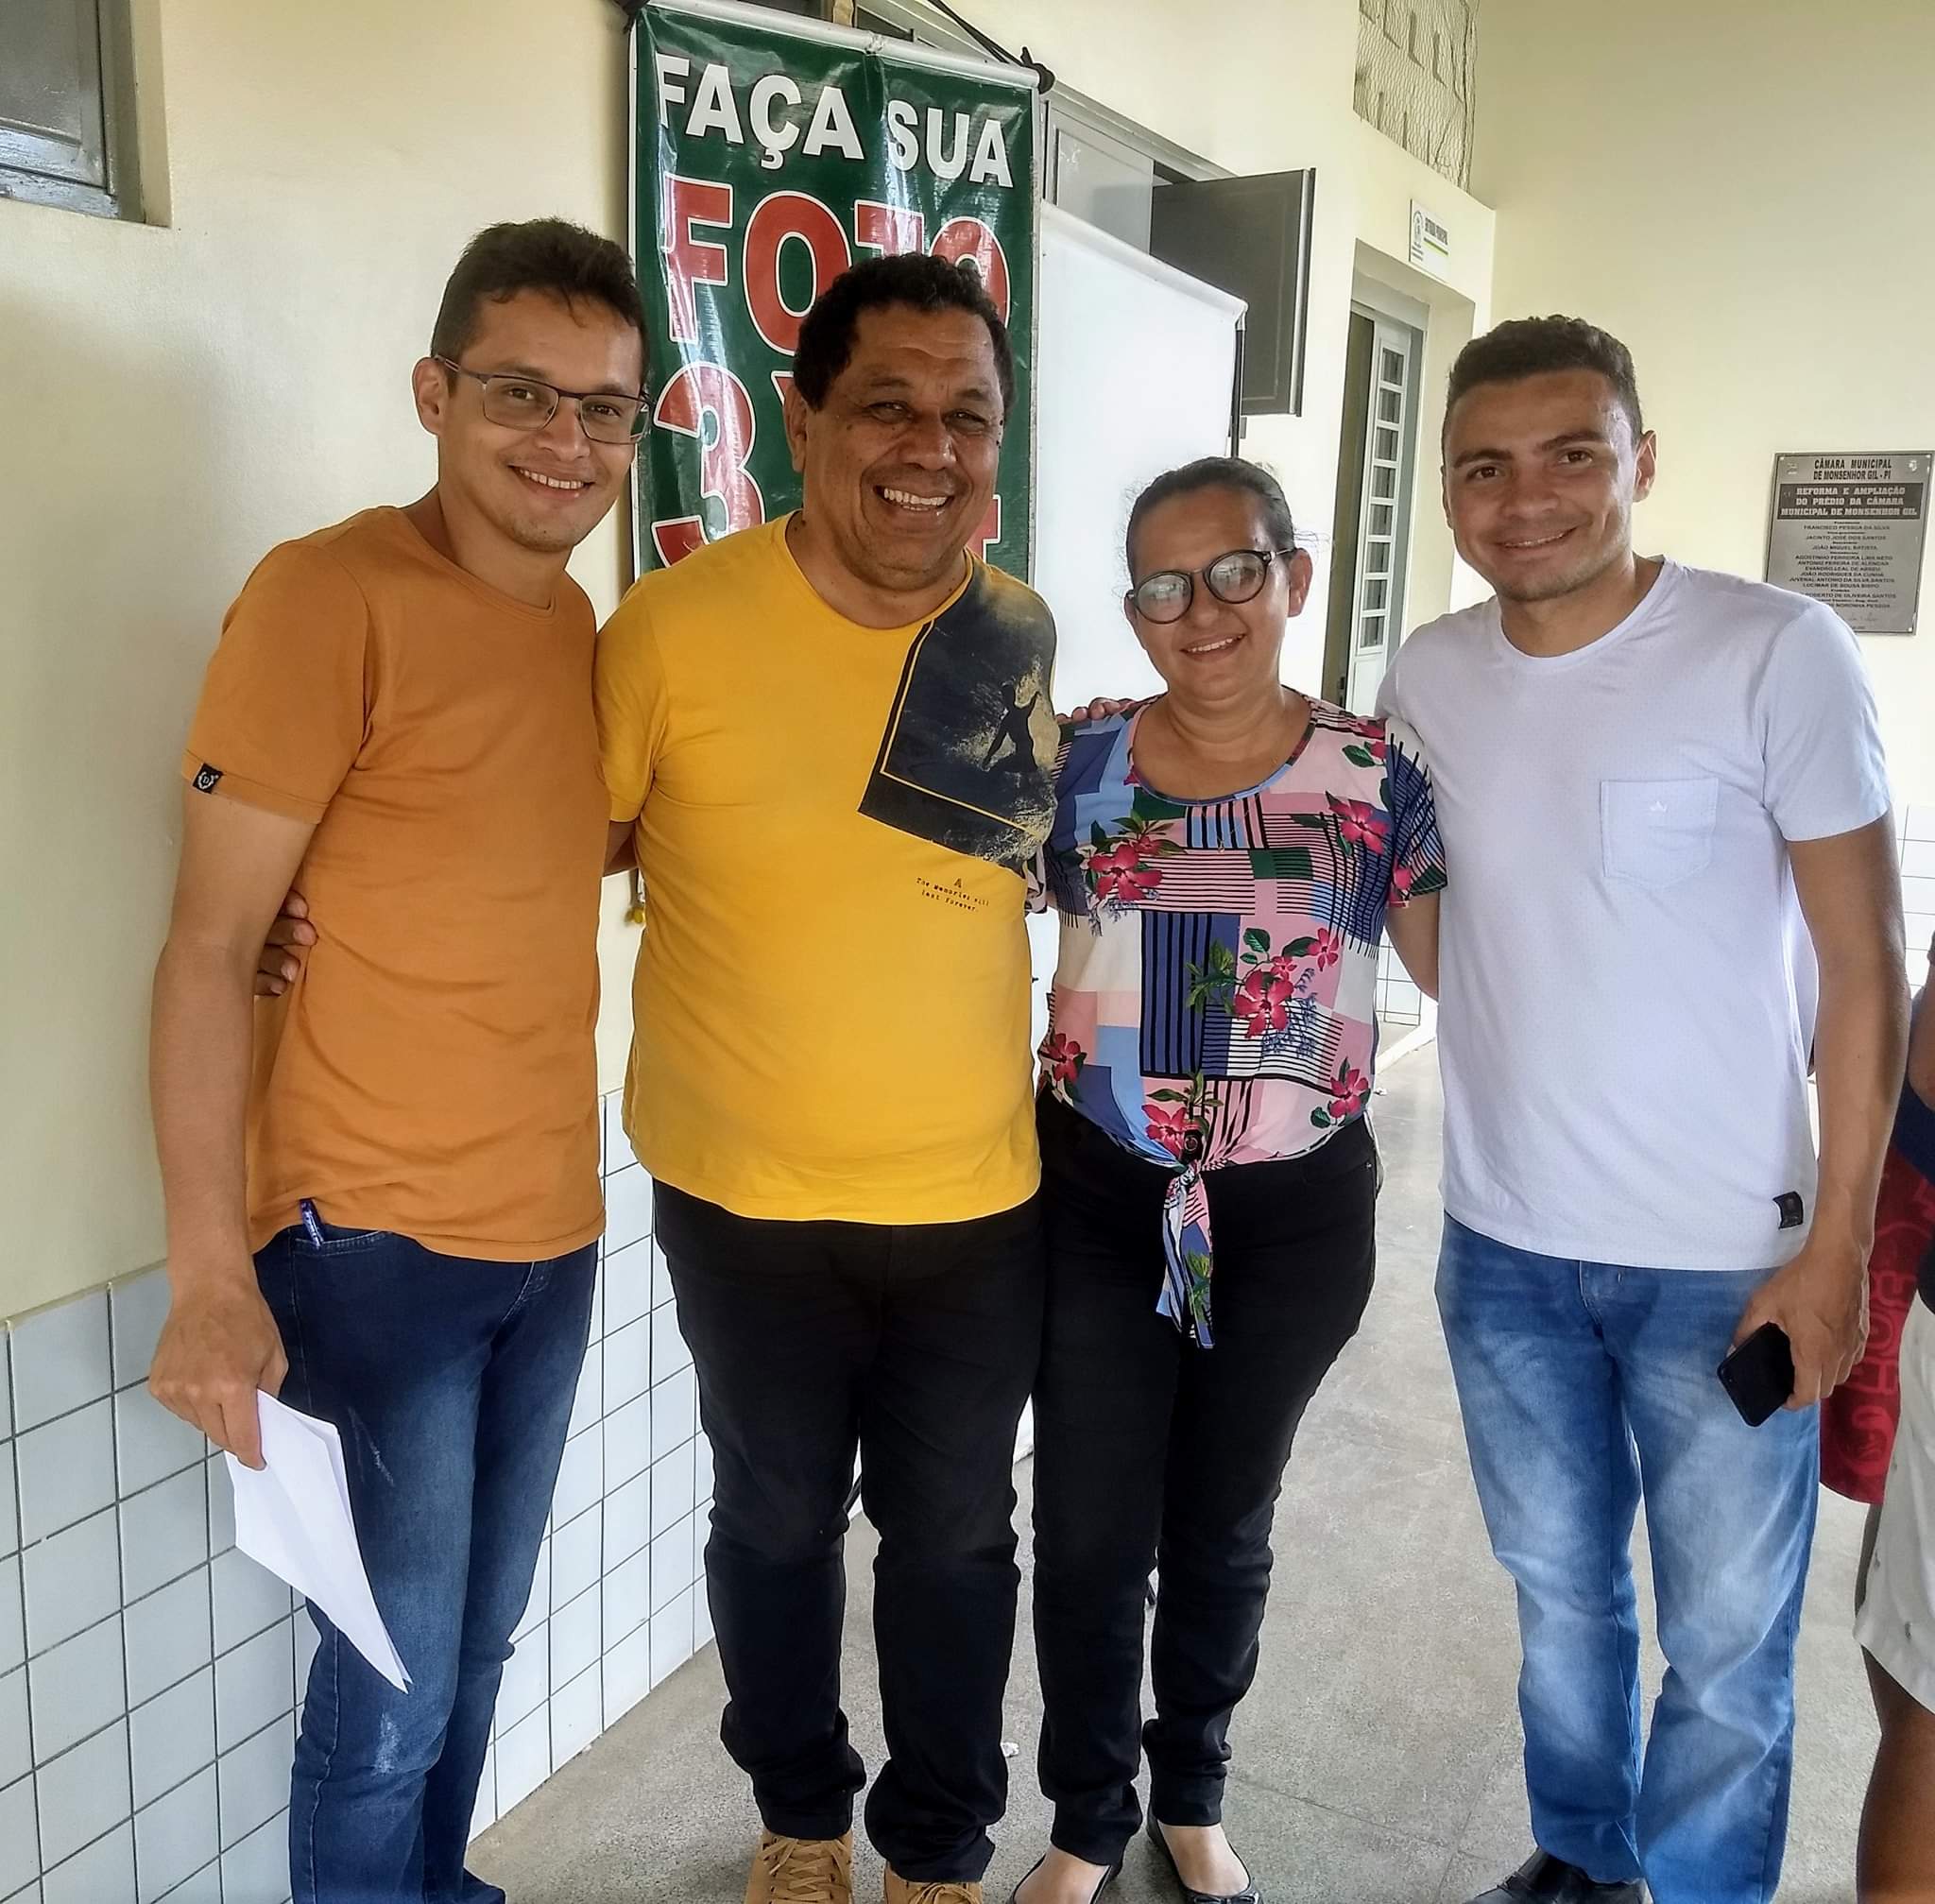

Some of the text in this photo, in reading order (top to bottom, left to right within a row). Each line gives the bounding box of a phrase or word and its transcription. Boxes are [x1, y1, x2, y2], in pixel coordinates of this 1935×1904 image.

[655, 51, 1014, 188] FAÇA SUA
[1815, 458, 1891, 469] CÂMARA MUNICIPAL
[1814, 471, 1822, 480] DE
[1824, 471, 1866, 480] MONSENHOR
[1867, 471, 1878, 480] GIL
[1884, 471, 1891, 480] PI
[1797, 486, 1905, 496] REFORMA E AMPLIAÇÃO
